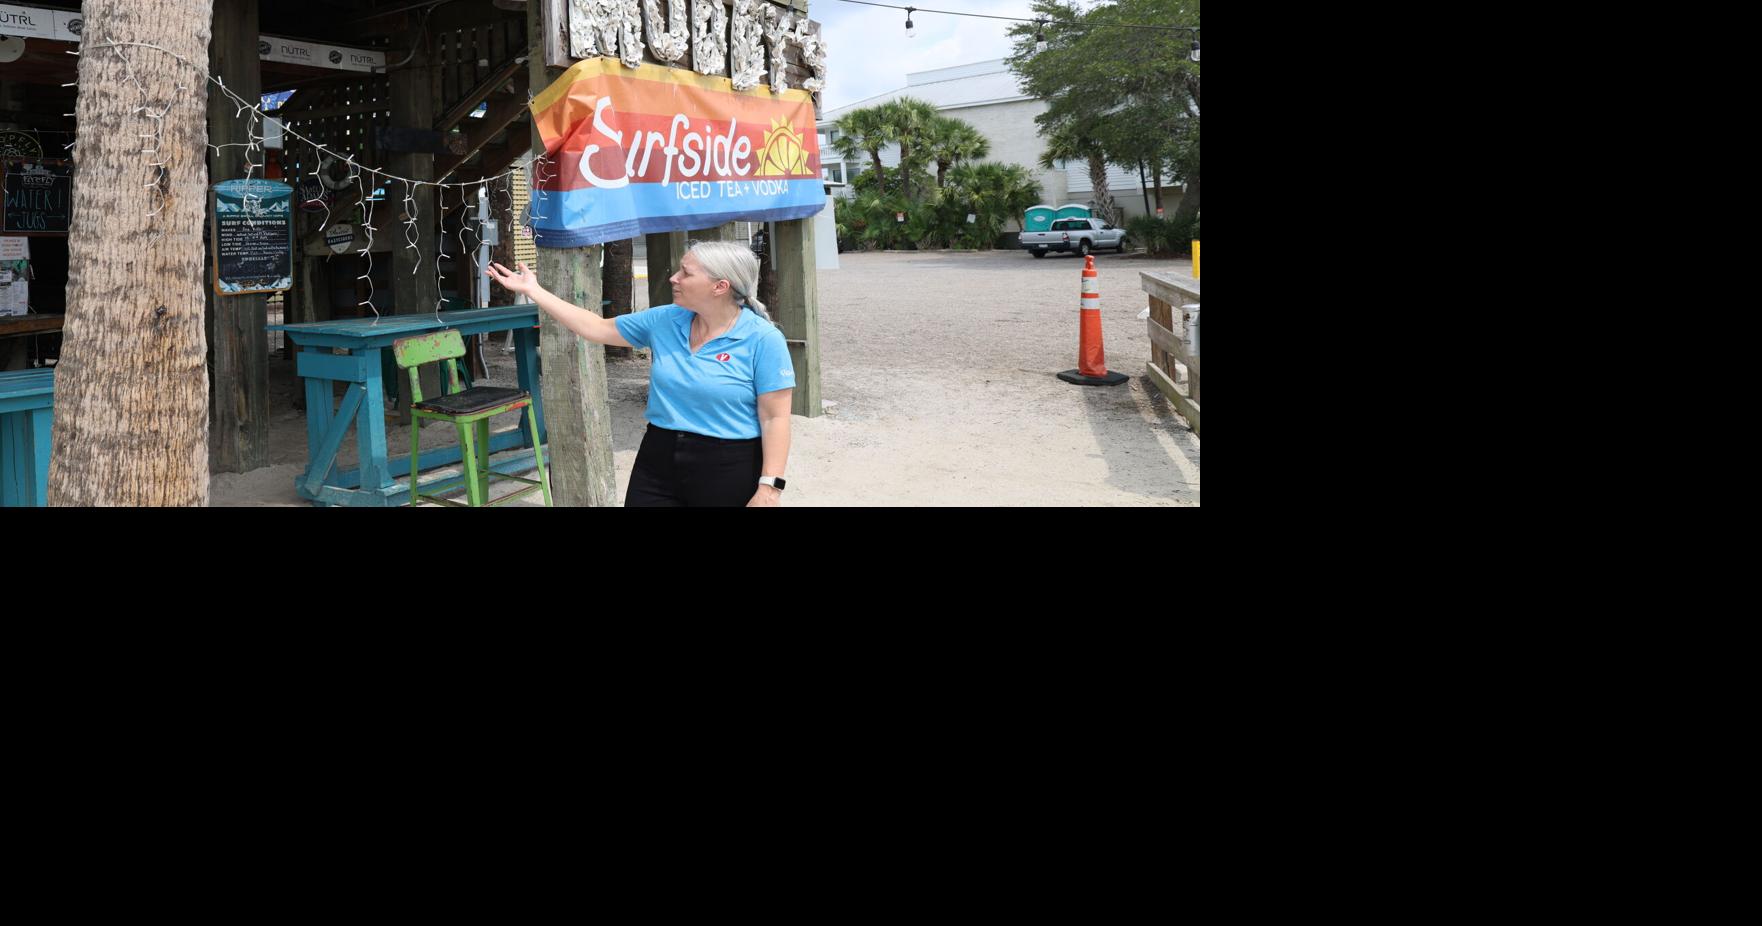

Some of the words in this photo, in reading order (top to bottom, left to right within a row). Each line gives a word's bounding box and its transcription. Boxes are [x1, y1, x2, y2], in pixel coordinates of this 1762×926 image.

[579, 96, 751, 188] Surfside
[676, 181, 711, 200] ICED
[717, 180, 743, 198] TEA
[752, 179, 789, 197] VODKA
